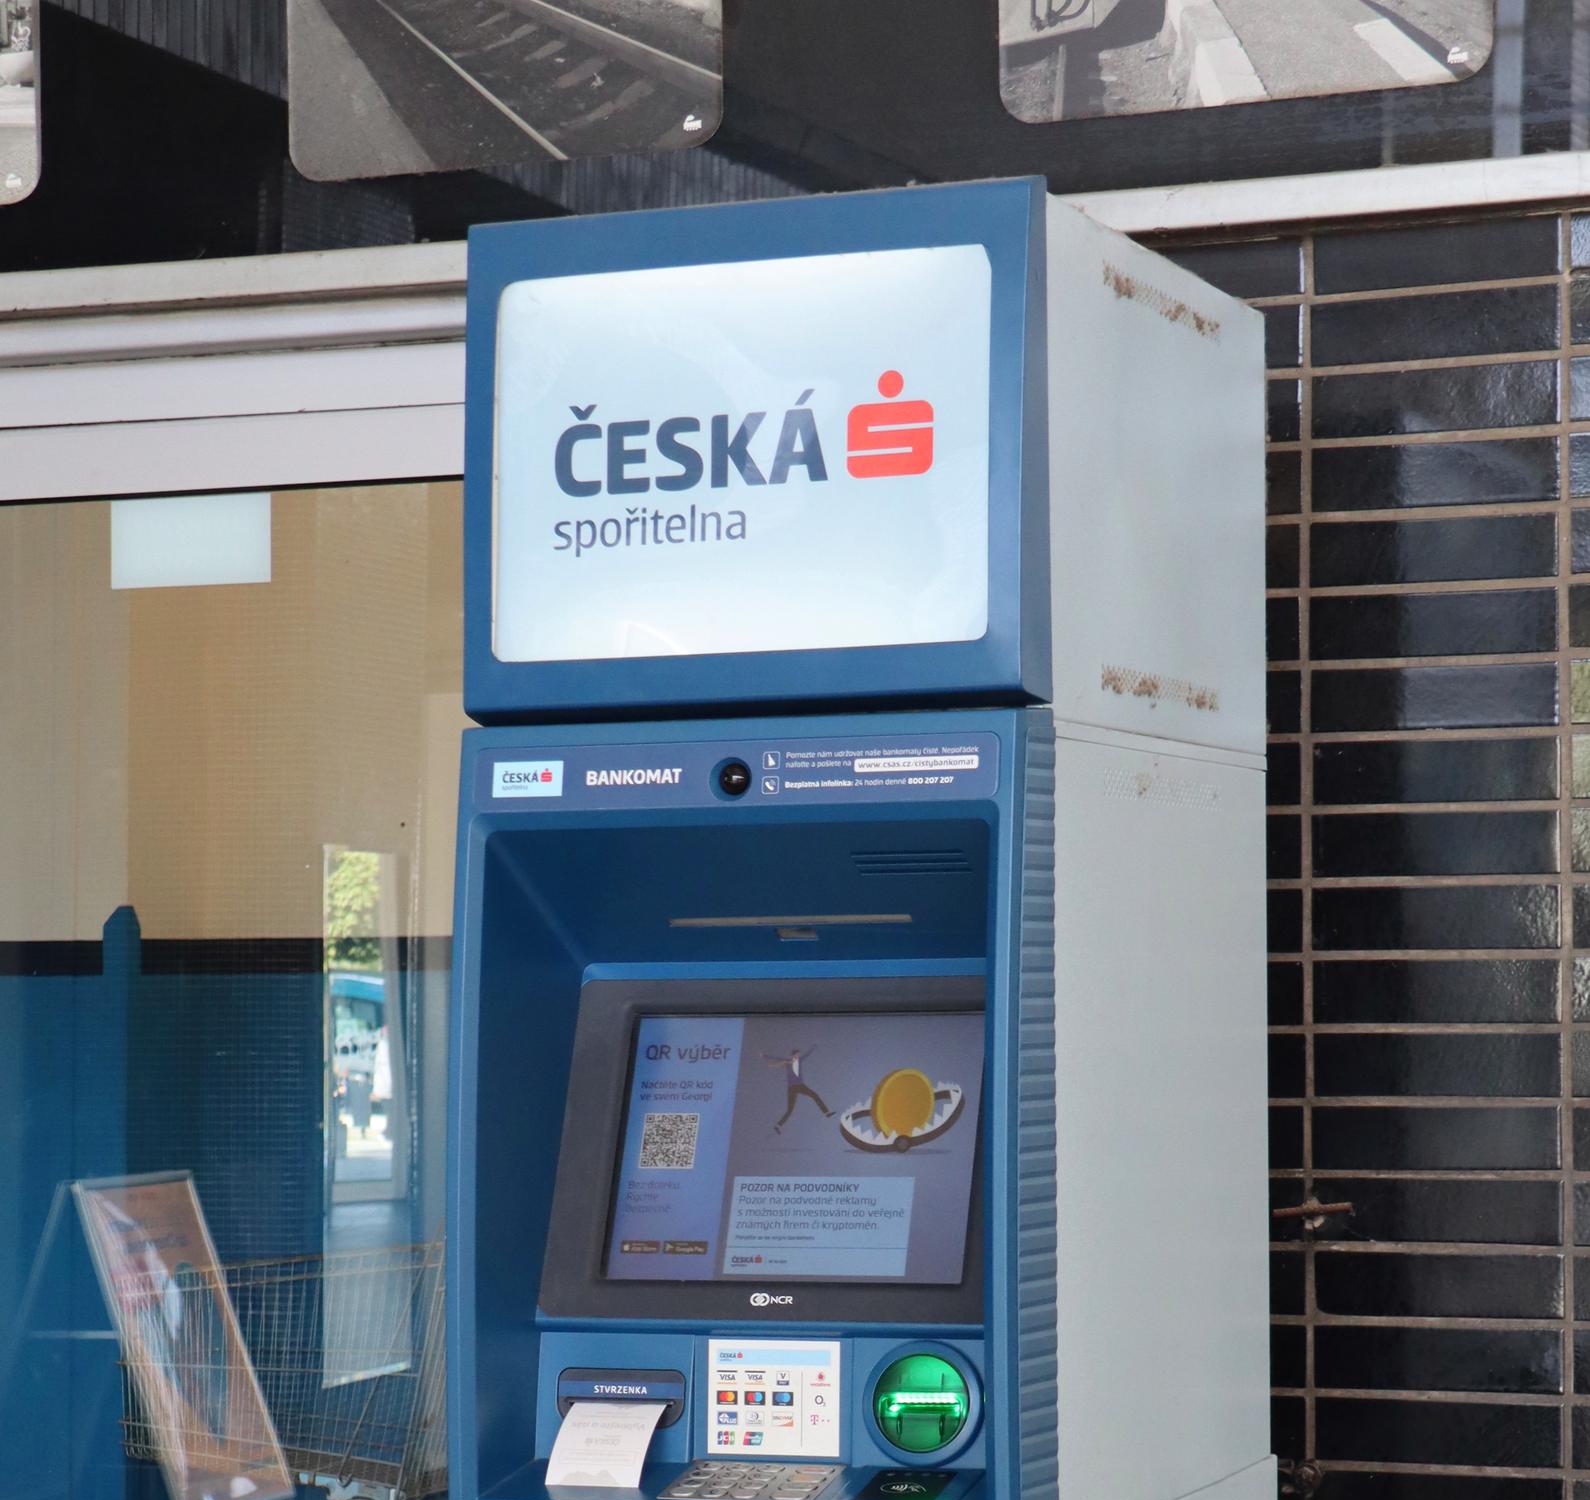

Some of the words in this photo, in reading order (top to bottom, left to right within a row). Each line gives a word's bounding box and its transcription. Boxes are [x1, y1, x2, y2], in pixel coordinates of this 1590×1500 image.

[554, 388, 829, 498] ČESKÁ
[553, 503, 747, 557] spořitelna
[786, 751, 815, 759] Pomozte
[883, 748, 921, 757] bankomaty
[858, 758, 974, 769] www.csas.cz/cistybankomat
[502, 769, 539, 783] ČESKÁ
[586, 768, 682, 786] BANKOMAT
[784, 781, 820, 789] Bezplatná
[821, 779, 854, 787] infolinka:
[864, 778, 883, 786] hodin
[925, 776, 938, 784] 207
[939, 776, 954, 784] 207
[646, 1044, 671, 1061] QR
[678, 1044, 731, 1064] výběr
[680, 1080, 695, 1089] QR
[740, 1183, 774, 1193] POZOR
[777, 1183, 790, 1193] NA
[793, 1182, 860, 1193] PODVODNÍKY
[738, 1195, 768, 1205] Pozor
[769, 1197, 782, 1205] na
[784, 1195, 832, 1206] podvodné
[835, 1195, 877, 1206] reklamy
[745, 1207, 790, 1217] možností
[792, 1207, 850, 1217] investování
[852, 1208, 864, 1217] do
[736, 1220, 780, 1231] známých
[783, 1220, 809, 1230] firem
[770, 1295, 793, 1304] NCR
[594, 1384, 648, 1394] STVRZENKA
